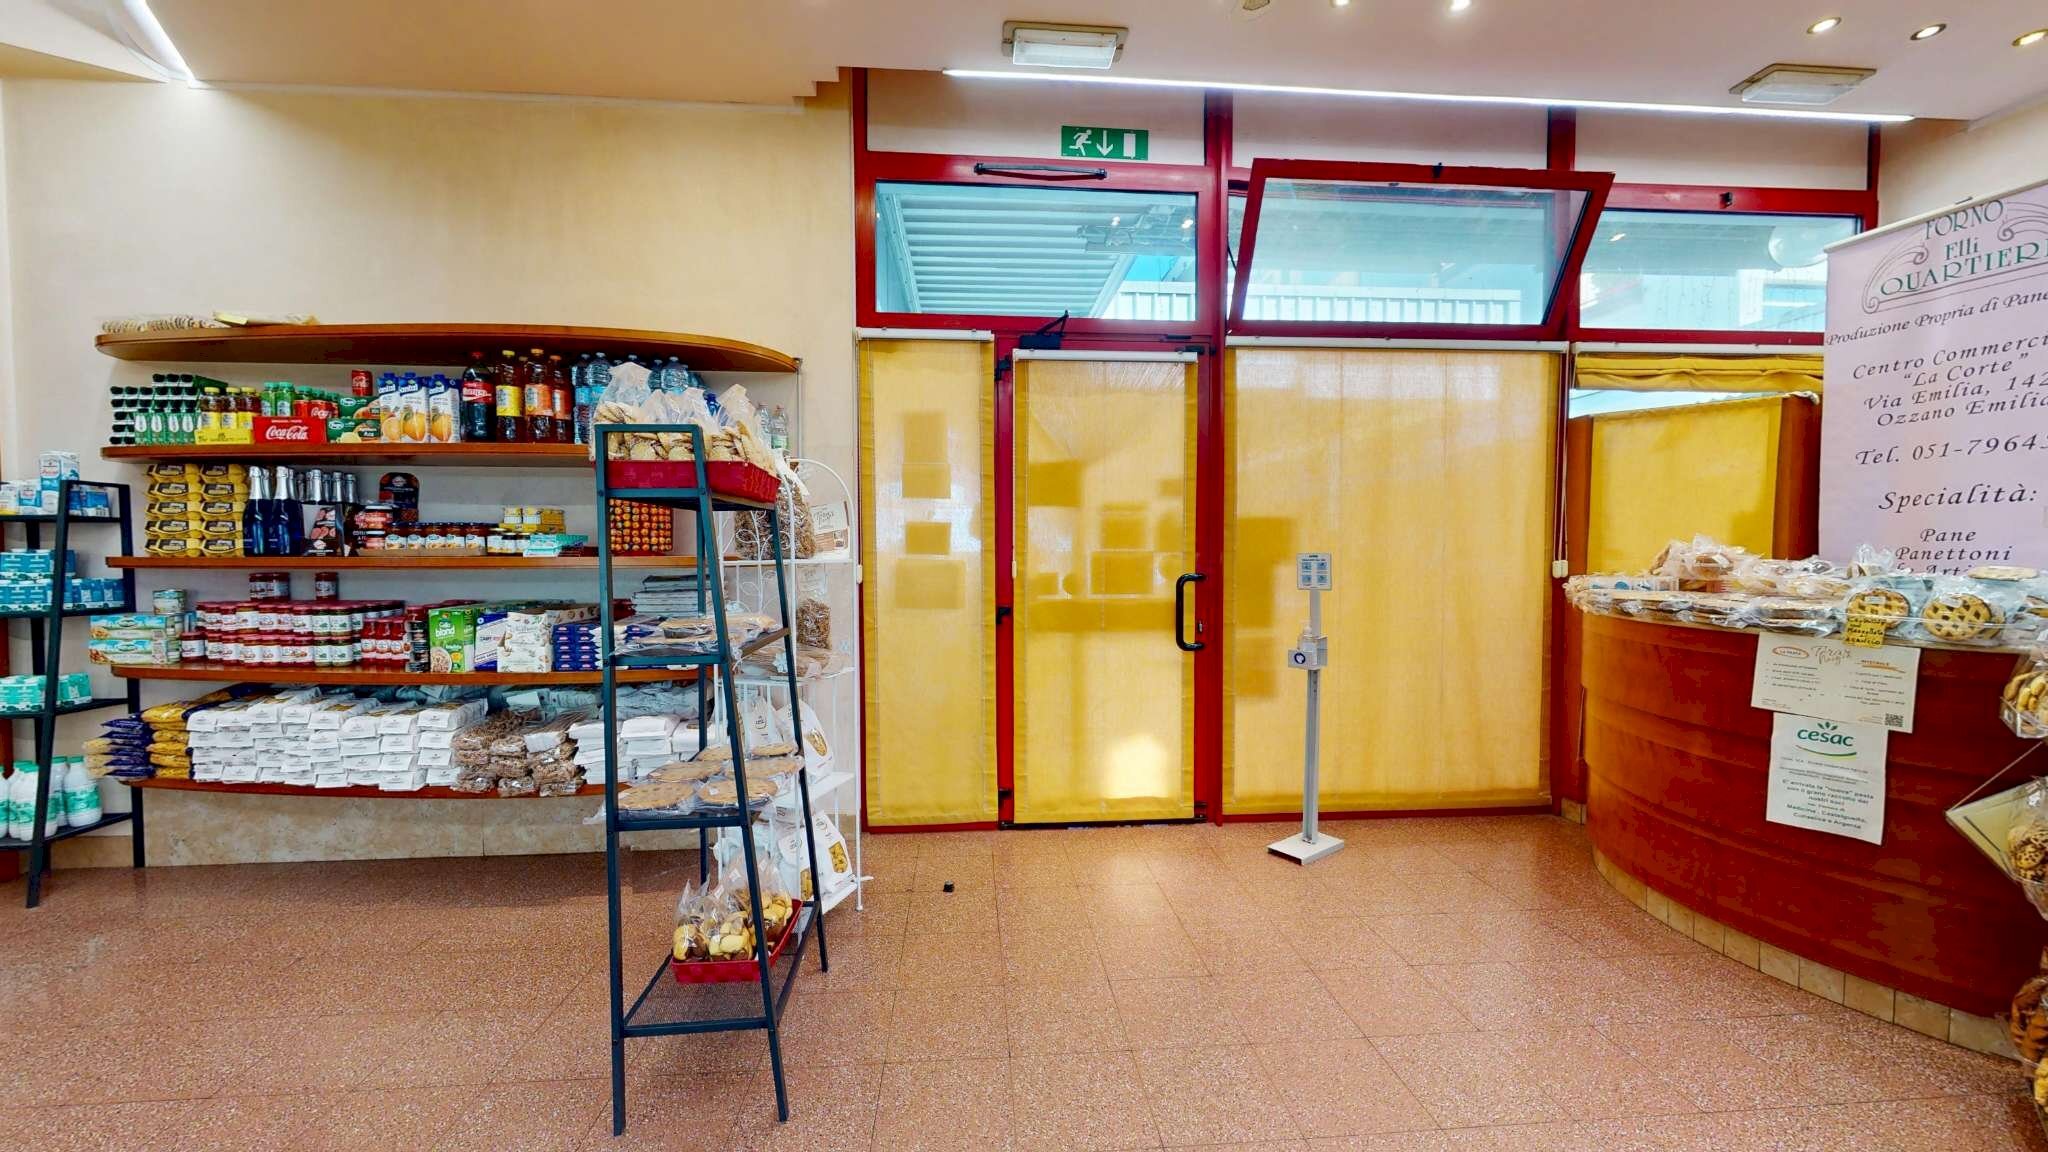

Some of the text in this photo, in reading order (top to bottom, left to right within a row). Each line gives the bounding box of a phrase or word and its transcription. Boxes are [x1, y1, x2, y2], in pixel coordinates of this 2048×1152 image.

[1827, 320, 1911, 346] Produzione
[1914, 305, 1974, 328] Propria
[1980, 297, 1998, 314] di
[1853, 357, 1925, 380] Centro
[1864, 395, 1903, 411] Via
[1912, 380, 1990, 406] Emilia,
[1877, 405, 1955, 427] Ozzano
[1855, 446, 1899, 465] Tel.
[1878, 483, 2038, 514] Specialità:
[1920, 528, 1977, 543] Pane
[1895, 545, 2013, 562] Panettoni
[1796, 728, 1855, 747] cesac
